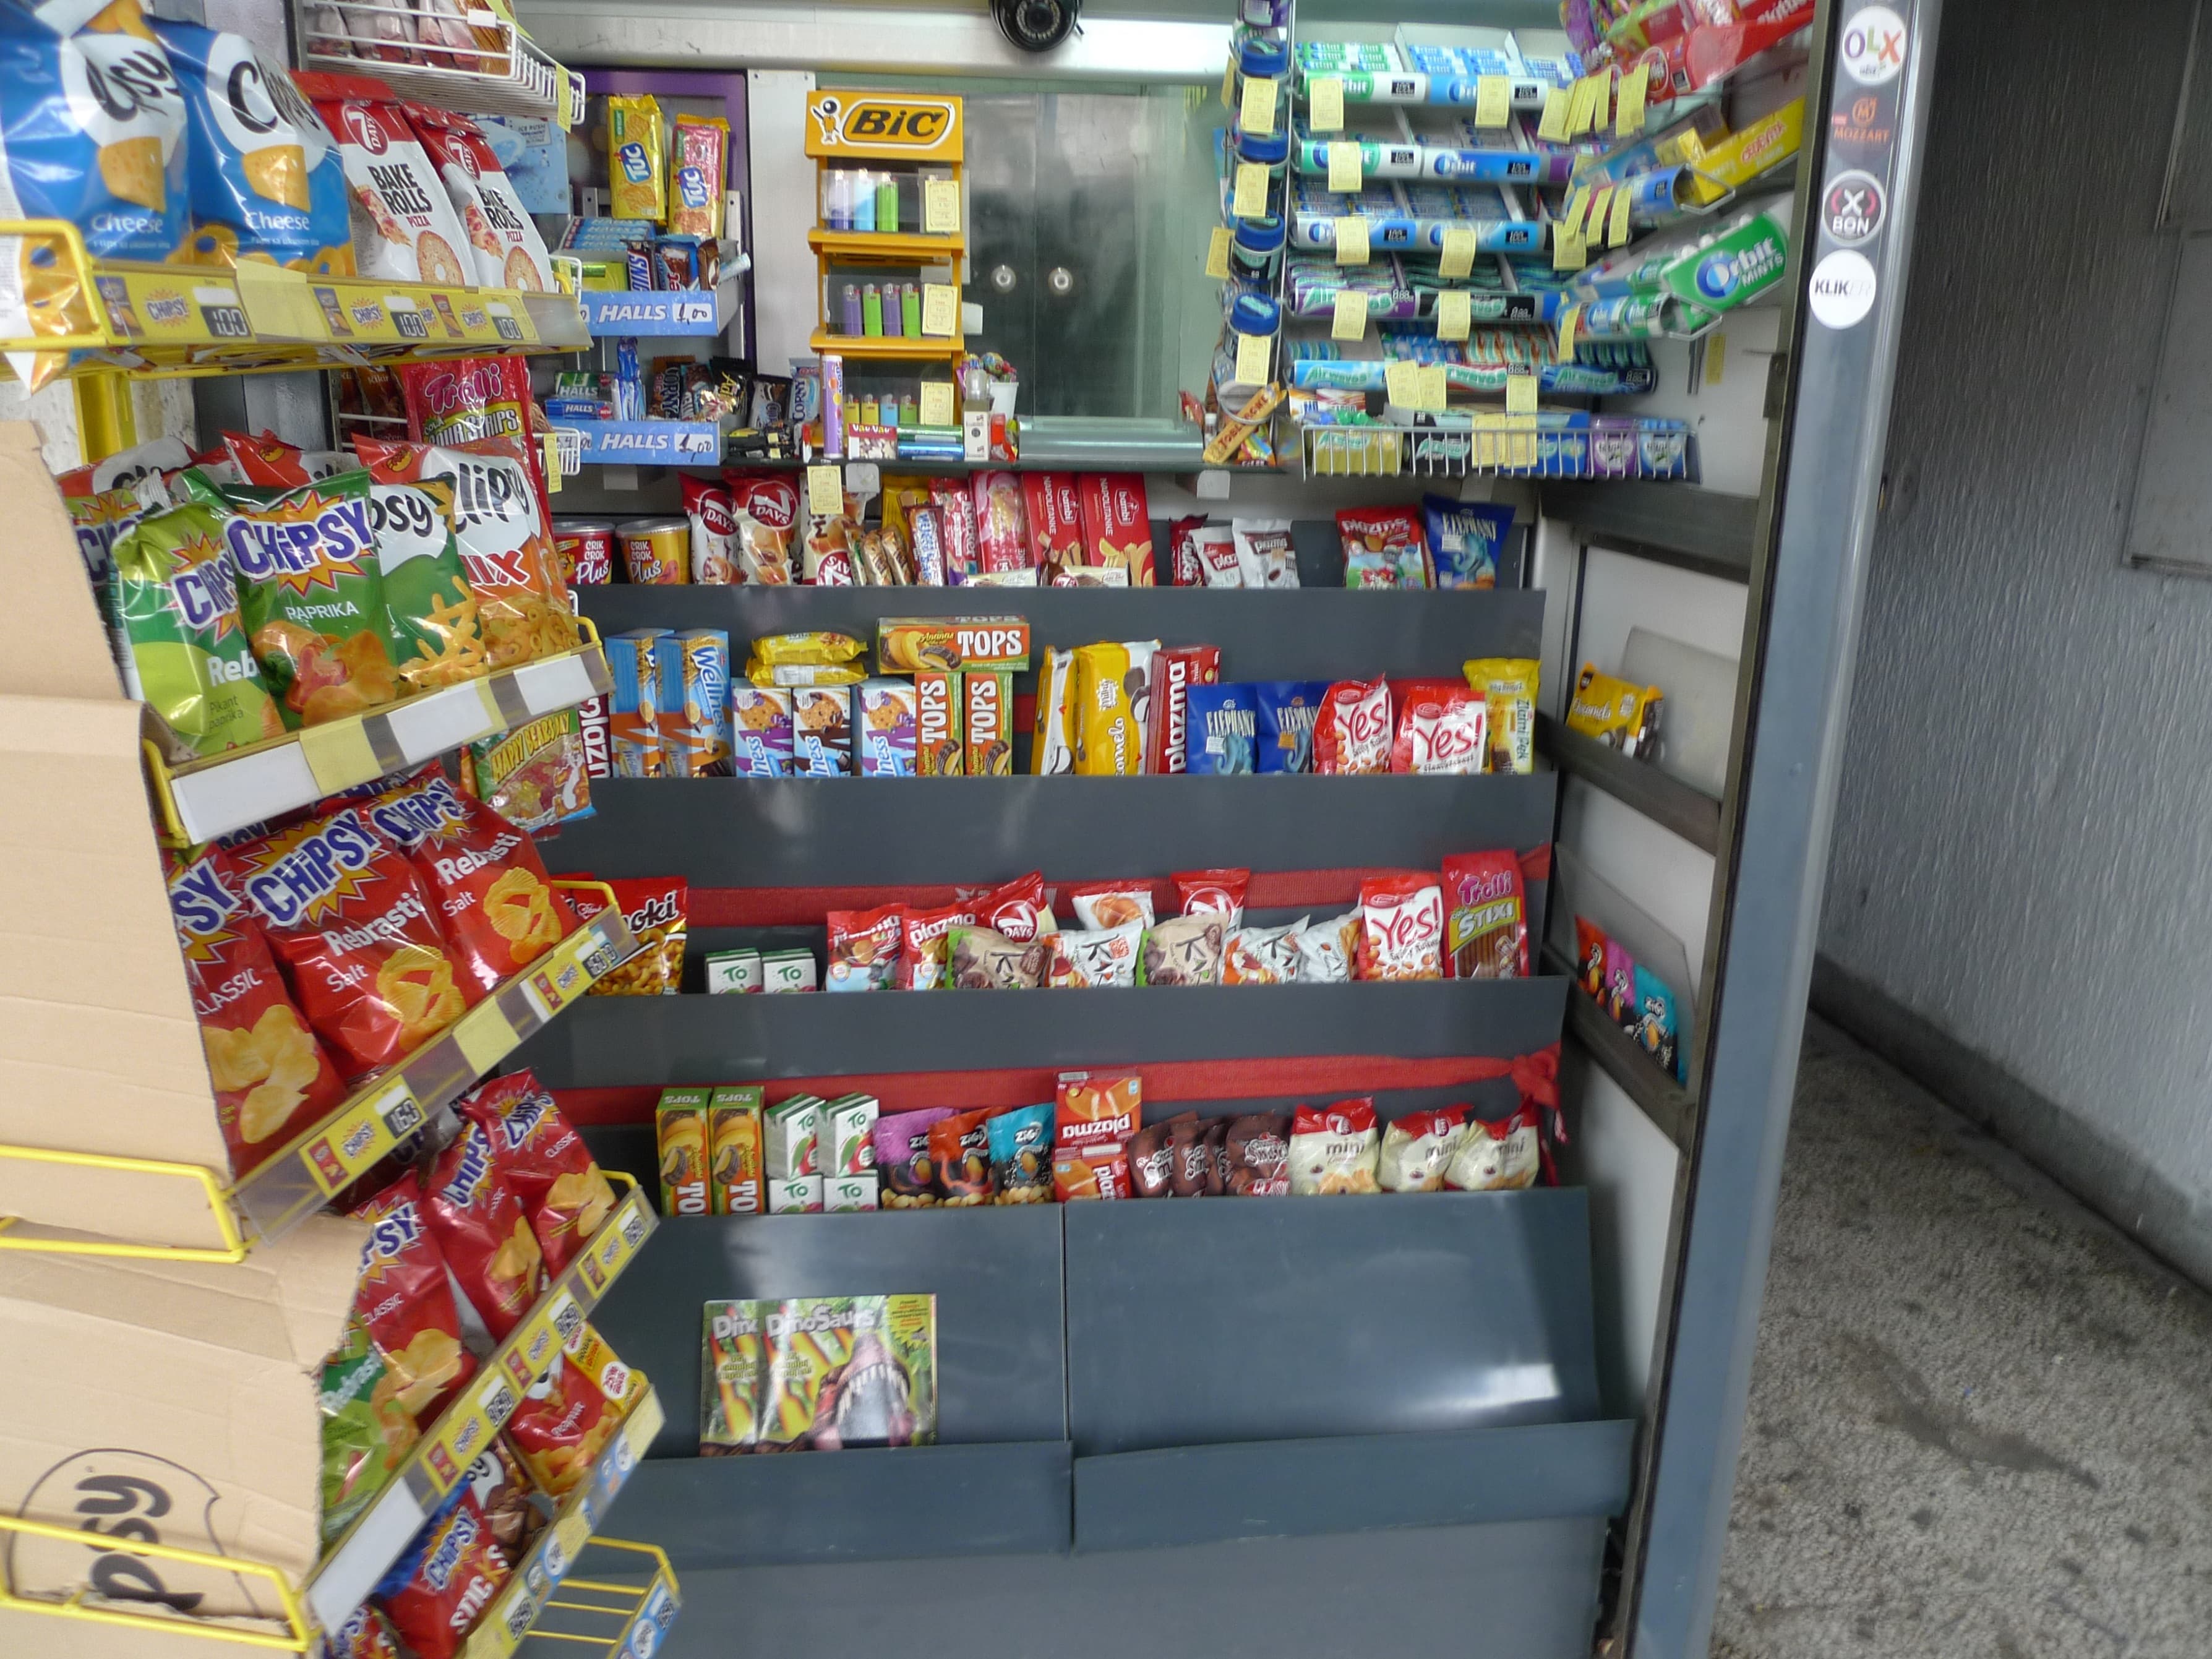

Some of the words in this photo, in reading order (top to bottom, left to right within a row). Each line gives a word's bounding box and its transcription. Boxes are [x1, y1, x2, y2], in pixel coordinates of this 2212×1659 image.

[1843, 25, 1901, 64] OLX
[850, 109, 945, 137] BIC
[1833, 127, 1890, 144] MOZZART
[367, 163, 419, 190] BAKE
[627, 145, 651, 183] TUC
[683, 169, 707, 207] TUC
[380, 188, 433, 215] ROLLS
[91, 213, 163, 233] Cheese
[249, 212, 310, 231] Cheese
[406, 216, 432, 228] PIZZA
[1832, 215, 1869, 235] BON
[505, 231, 523, 243] PIZZA
[1696, 237, 1775, 299] Orbit
[1741, 253, 1784, 288] MINTS
[598, 304, 667, 324] HALLS
[423, 363, 502, 414] Trolli
[559, 385, 598, 398] HALLS
[792, 379, 806, 423] CORNY
[565, 403, 594, 414] HALLS
[599, 434, 669, 451] HALLS
[755, 505, 791, 526] DAYS
[1061, 489, 1074, 521] bambi
[1118, 491, 1131, 522] bambi
[706, 510, 739, 534] DAYS
[1340, 518, 1410, 534] plazma
[584, 550, 605, 561] CROK
[585, 539, 604, 551] CRIK
[630, 541, 650, 552] CRIK
[630, 551, 653, 561] CROK
[575, 559, 610, 584] Plus
[630, 559, 662, 585] Plus
[1213, 553, 1238, 572] plaz
[285, 601, 360, 622] PAPRIKA
[919, 631, 955, 643] Ananas
[957, 630, 1023, 656] TOPS
[690, 646, 726, 737] Wellness
[208, 695, 239, 715] Pikant
[920, 679, 948, 745] TOPS
[971, 679, 997, 745] TOPS
[1164, 659, 1186, 774] plazma
[207, 708, 244, 732] paprika
[1337, 691, 1390, 746] Yes!
[1415, 713, 1483, 761] Yes!
[489, 735, 525, 784] HAPPY
[1457, 870, 1513, 906] Trolli
[441, 890, 477, 917] Salt
[324, 890, 427, 958] Rebrasti
[1003, 925, 1034, 938] DAYS
[1371, 894, 1441, 951] Yes!
[1457, 901, 1514, 941] STIXI
[326, 963, 369, 993] Salt
[722, 966, 748, 982] TO
[777, 966, 802, 982] TO
[797, 1113, 815, 1131] TO
[848, 1111, 867, 1130] TO
[1062, 1113, 1131, 1139] plazma
[1325, 1142, 1365, 1155] mini
[1425, 1137, 1459, 1161] mini
[677, 1181, 706, 1215] TO
[728, 1180, 758, 1215] TO
[783, 1183, 809, 1198] TO
[836, 1183, 863, 1199] TO
